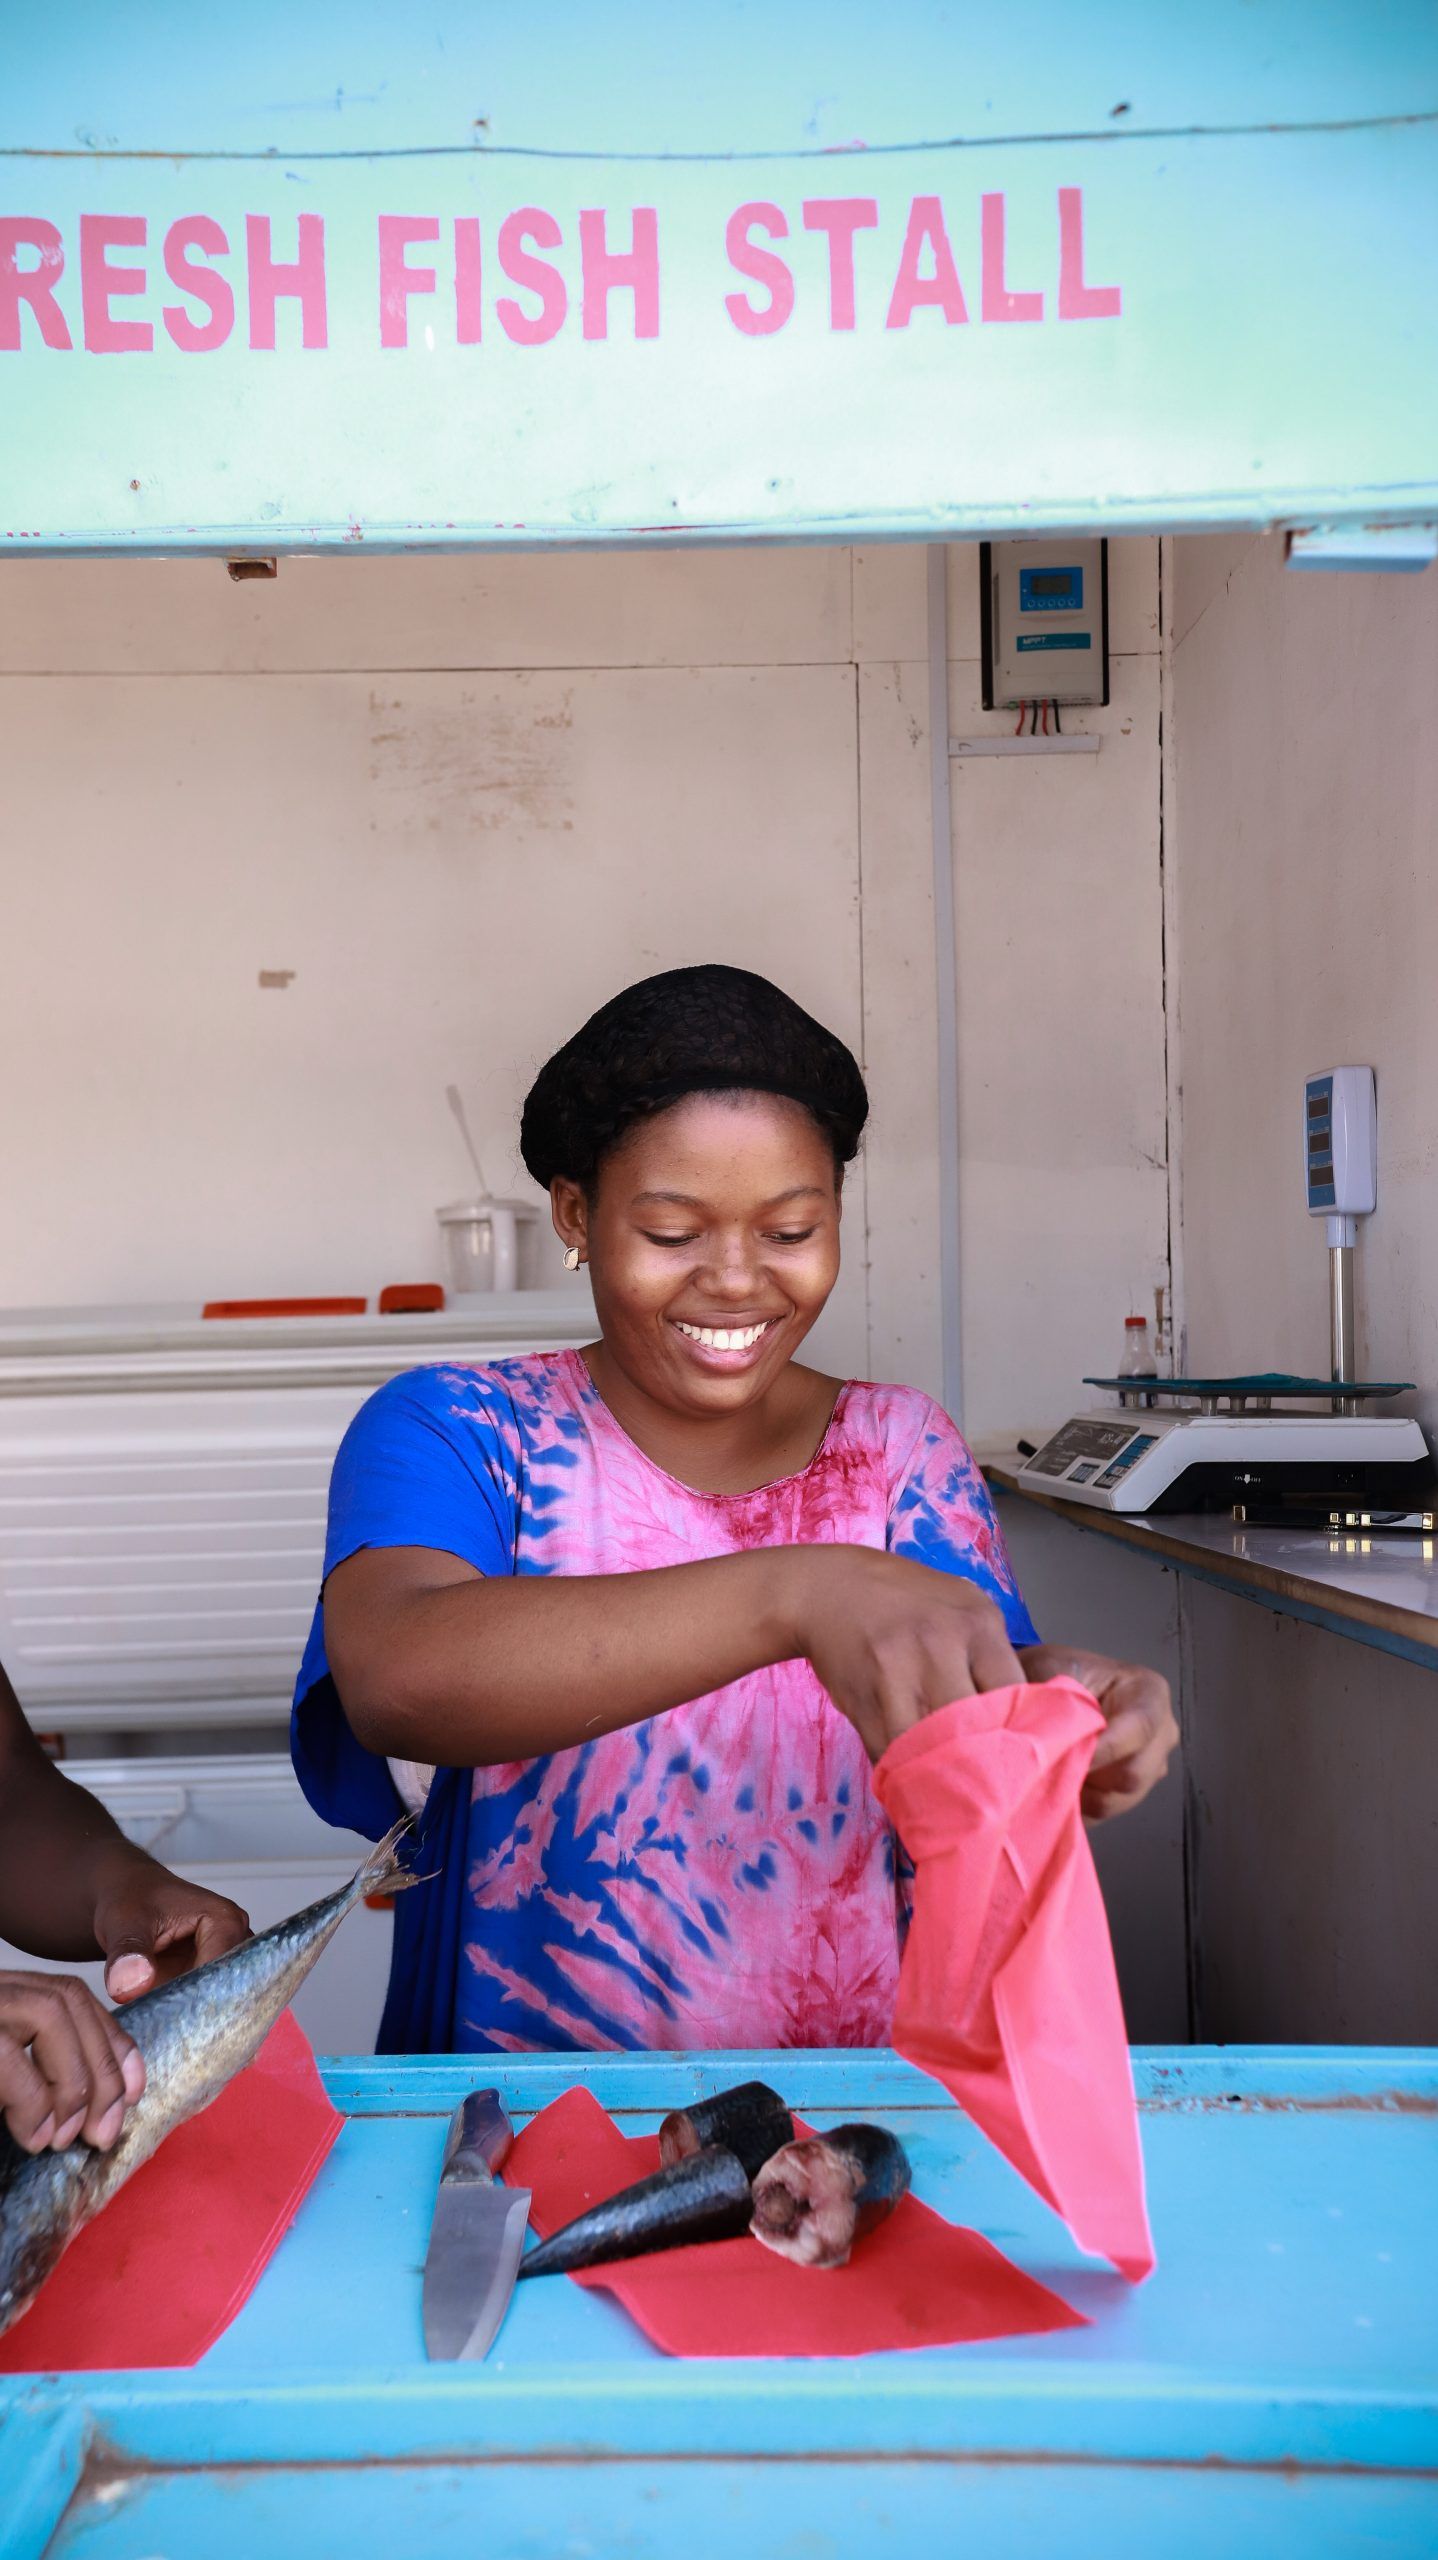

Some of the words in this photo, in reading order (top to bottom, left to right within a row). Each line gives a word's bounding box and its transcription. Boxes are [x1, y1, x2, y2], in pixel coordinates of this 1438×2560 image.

[0, 213, 328, 354] RESH
[378, 206, 660, 348] FISH
[724, 187, 1121, 336] STALL
